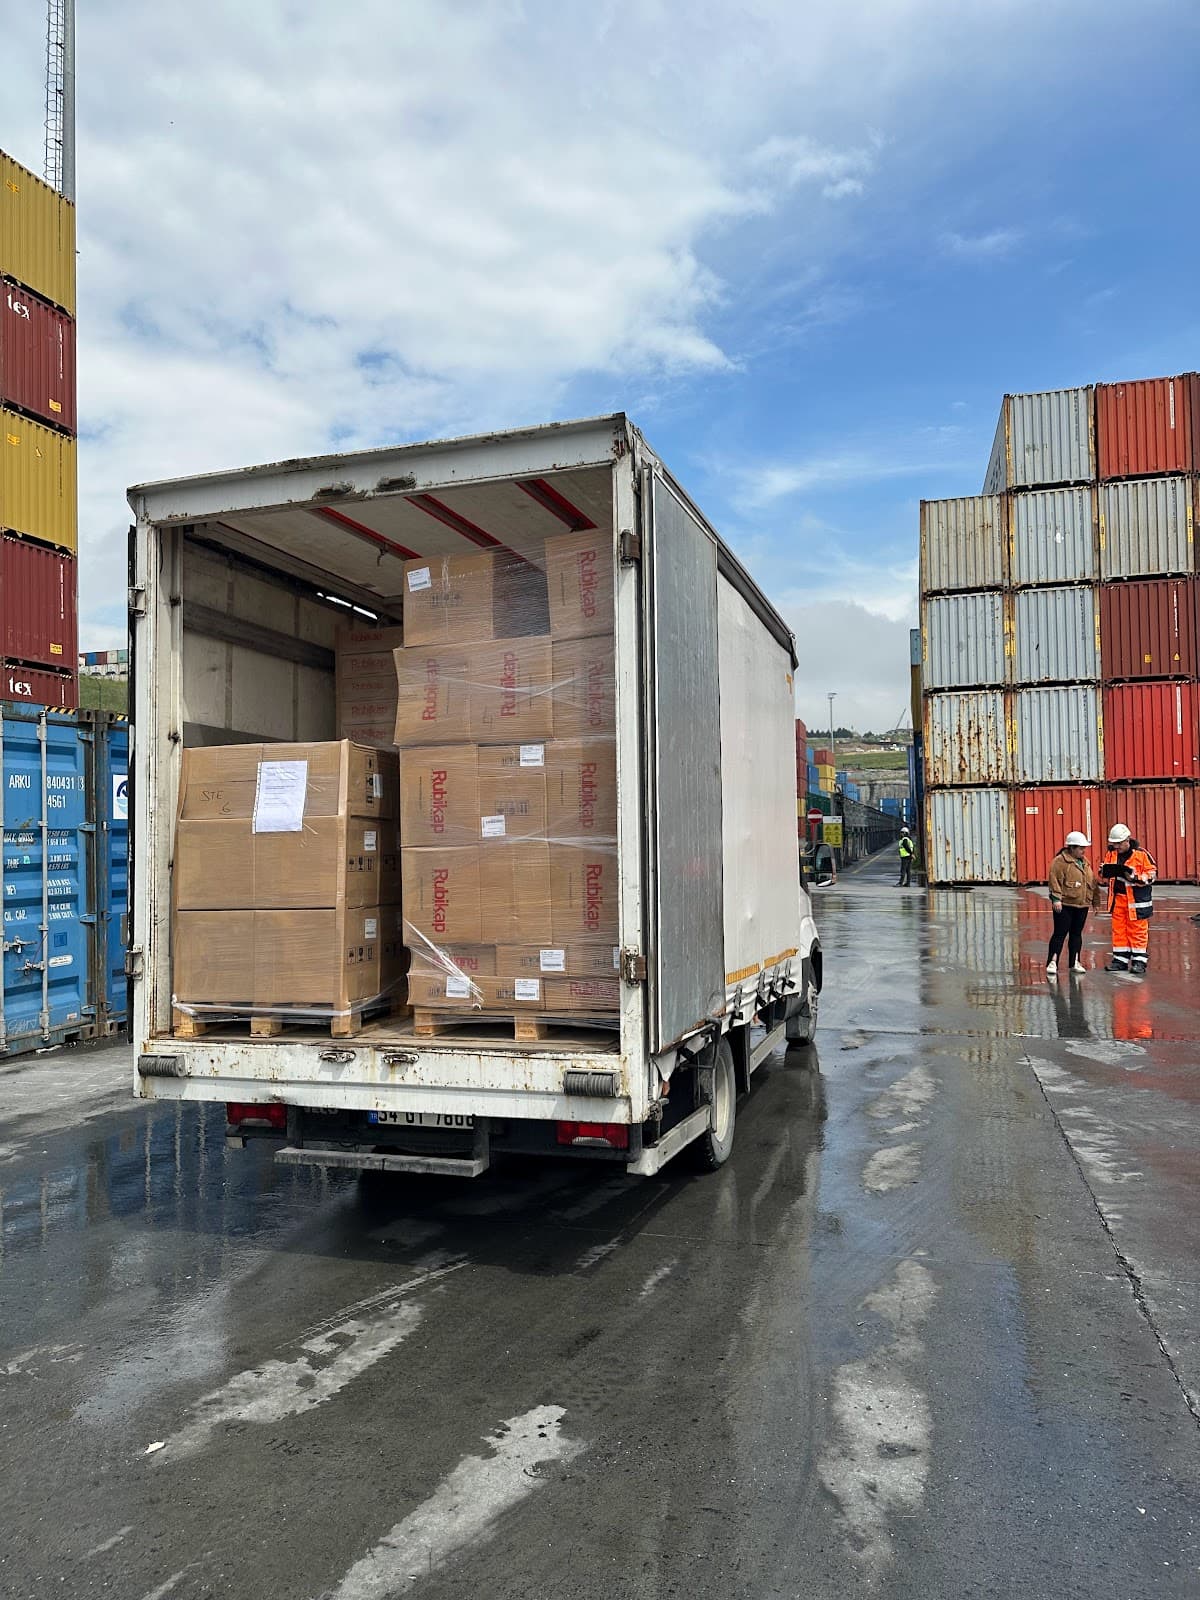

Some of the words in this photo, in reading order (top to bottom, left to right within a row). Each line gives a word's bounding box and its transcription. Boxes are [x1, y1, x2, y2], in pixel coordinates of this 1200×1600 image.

[580, 549, 599, 619] Rubikap
[8, 675, 33, 697] tex
[9, 774, 31, 789] ARKU
[46, 775, 75, 790] 840431
[47, 795, 66, 809] 45G1
[431, 768, 448, 834] Rubikap
[579, 761, 597, 829] Rubikap
[434, 868, 449, 933] Rubikap
[584, 864, 603, 932] Rubikap
